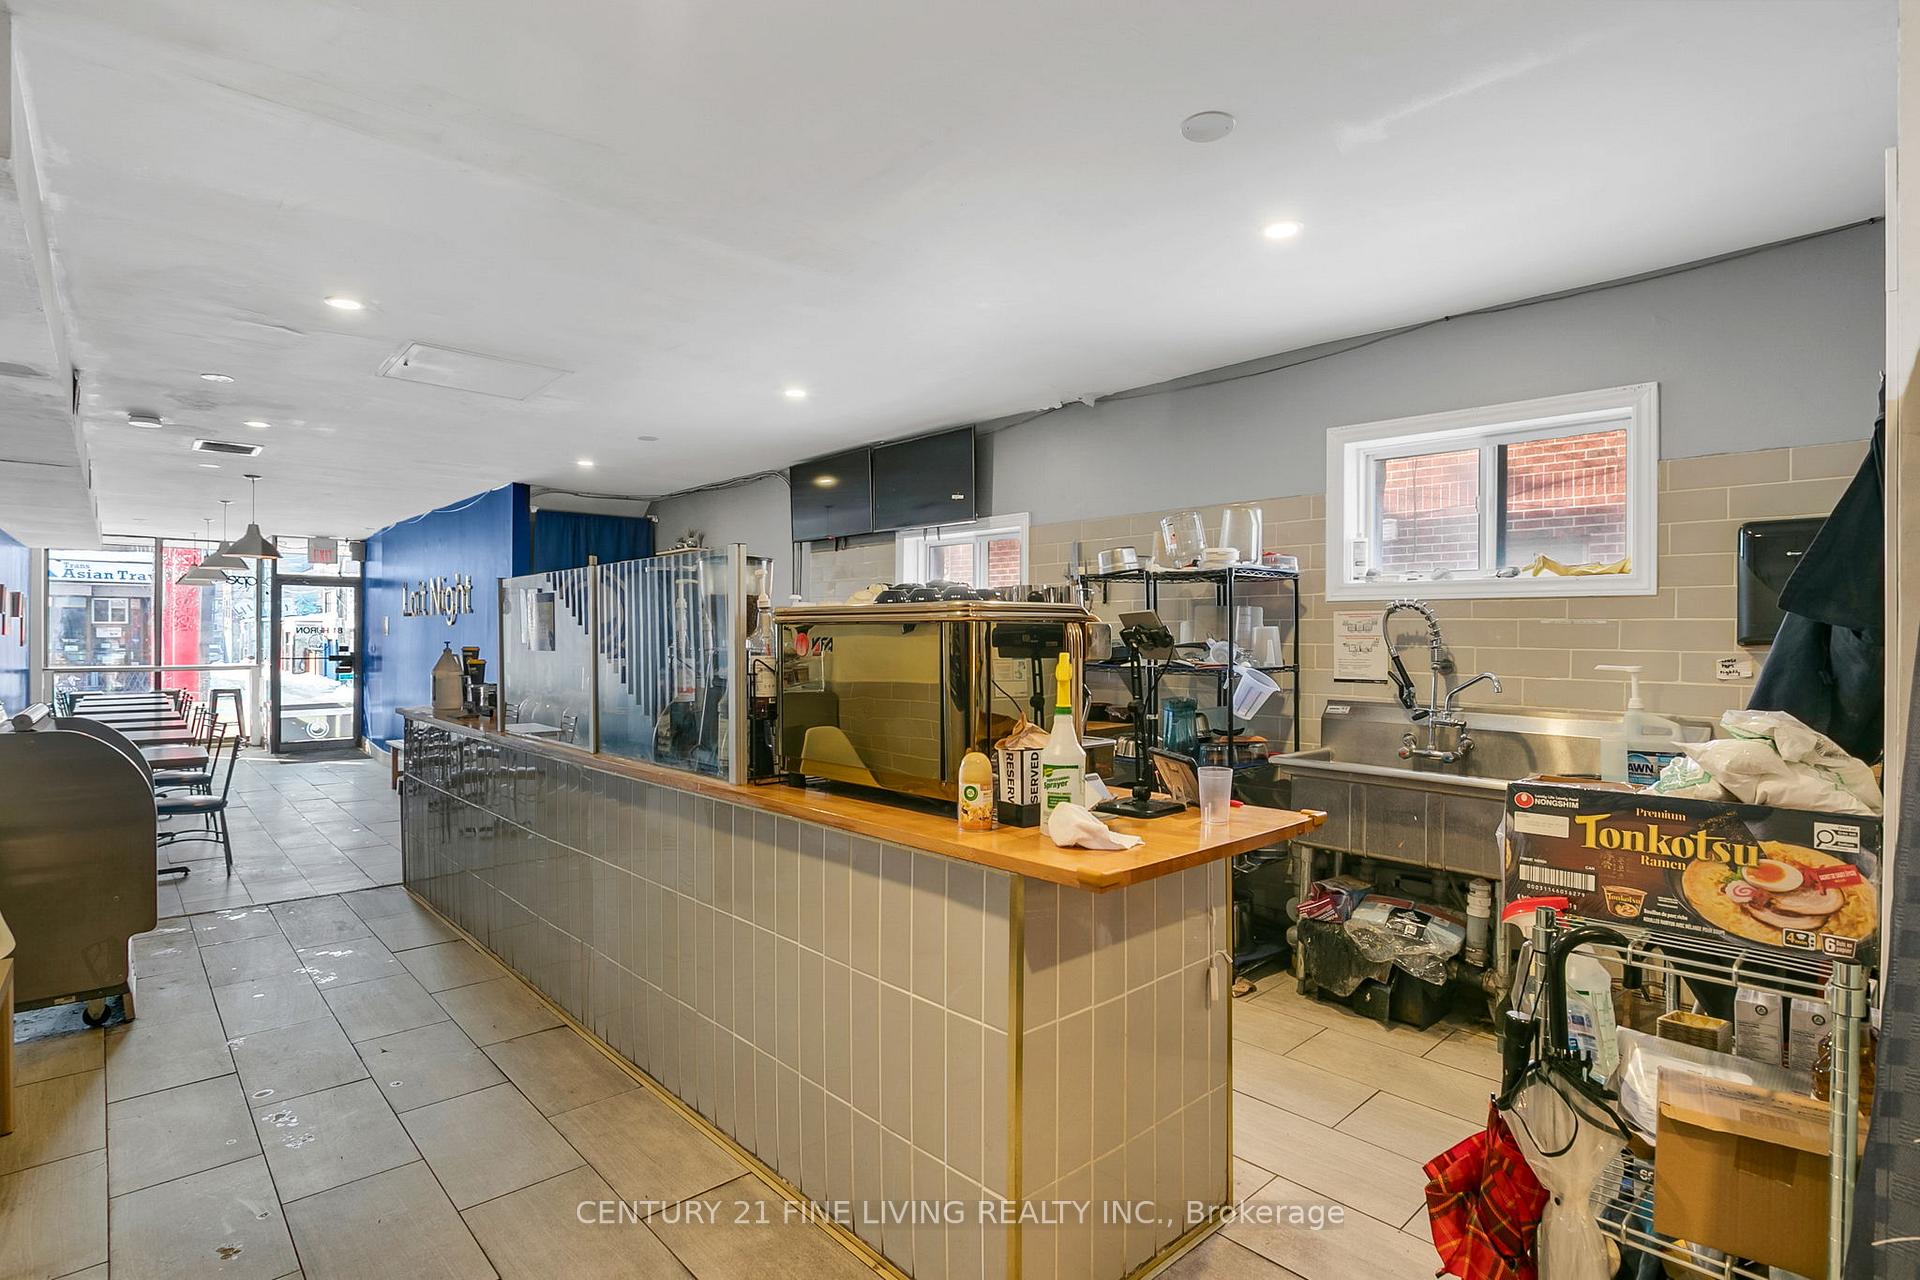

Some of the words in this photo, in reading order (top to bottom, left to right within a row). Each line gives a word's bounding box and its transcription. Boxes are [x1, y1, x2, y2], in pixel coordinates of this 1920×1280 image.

[62, 569, 114, 580] Asian
[1628, 763, 1654, 774] AWN
[1005, 752, 1015, 804] RESERV
[1030, 751, 1039, 804] SERVED
[1043, 780, 1068, 790] Sprayer
[1534, 798, 1579, 809] NONGSHIM
[1636, 807, 1687, 822] Premium
[1574, 813, 1760, 868] Tonkotsu
[1640, 855, 1687, 871] Ramen
[1607, 892, 1641, 904] Tonkotsu
[1786, 932, 1794, 944] 4
[1824, 938, 1836, 953] 6
